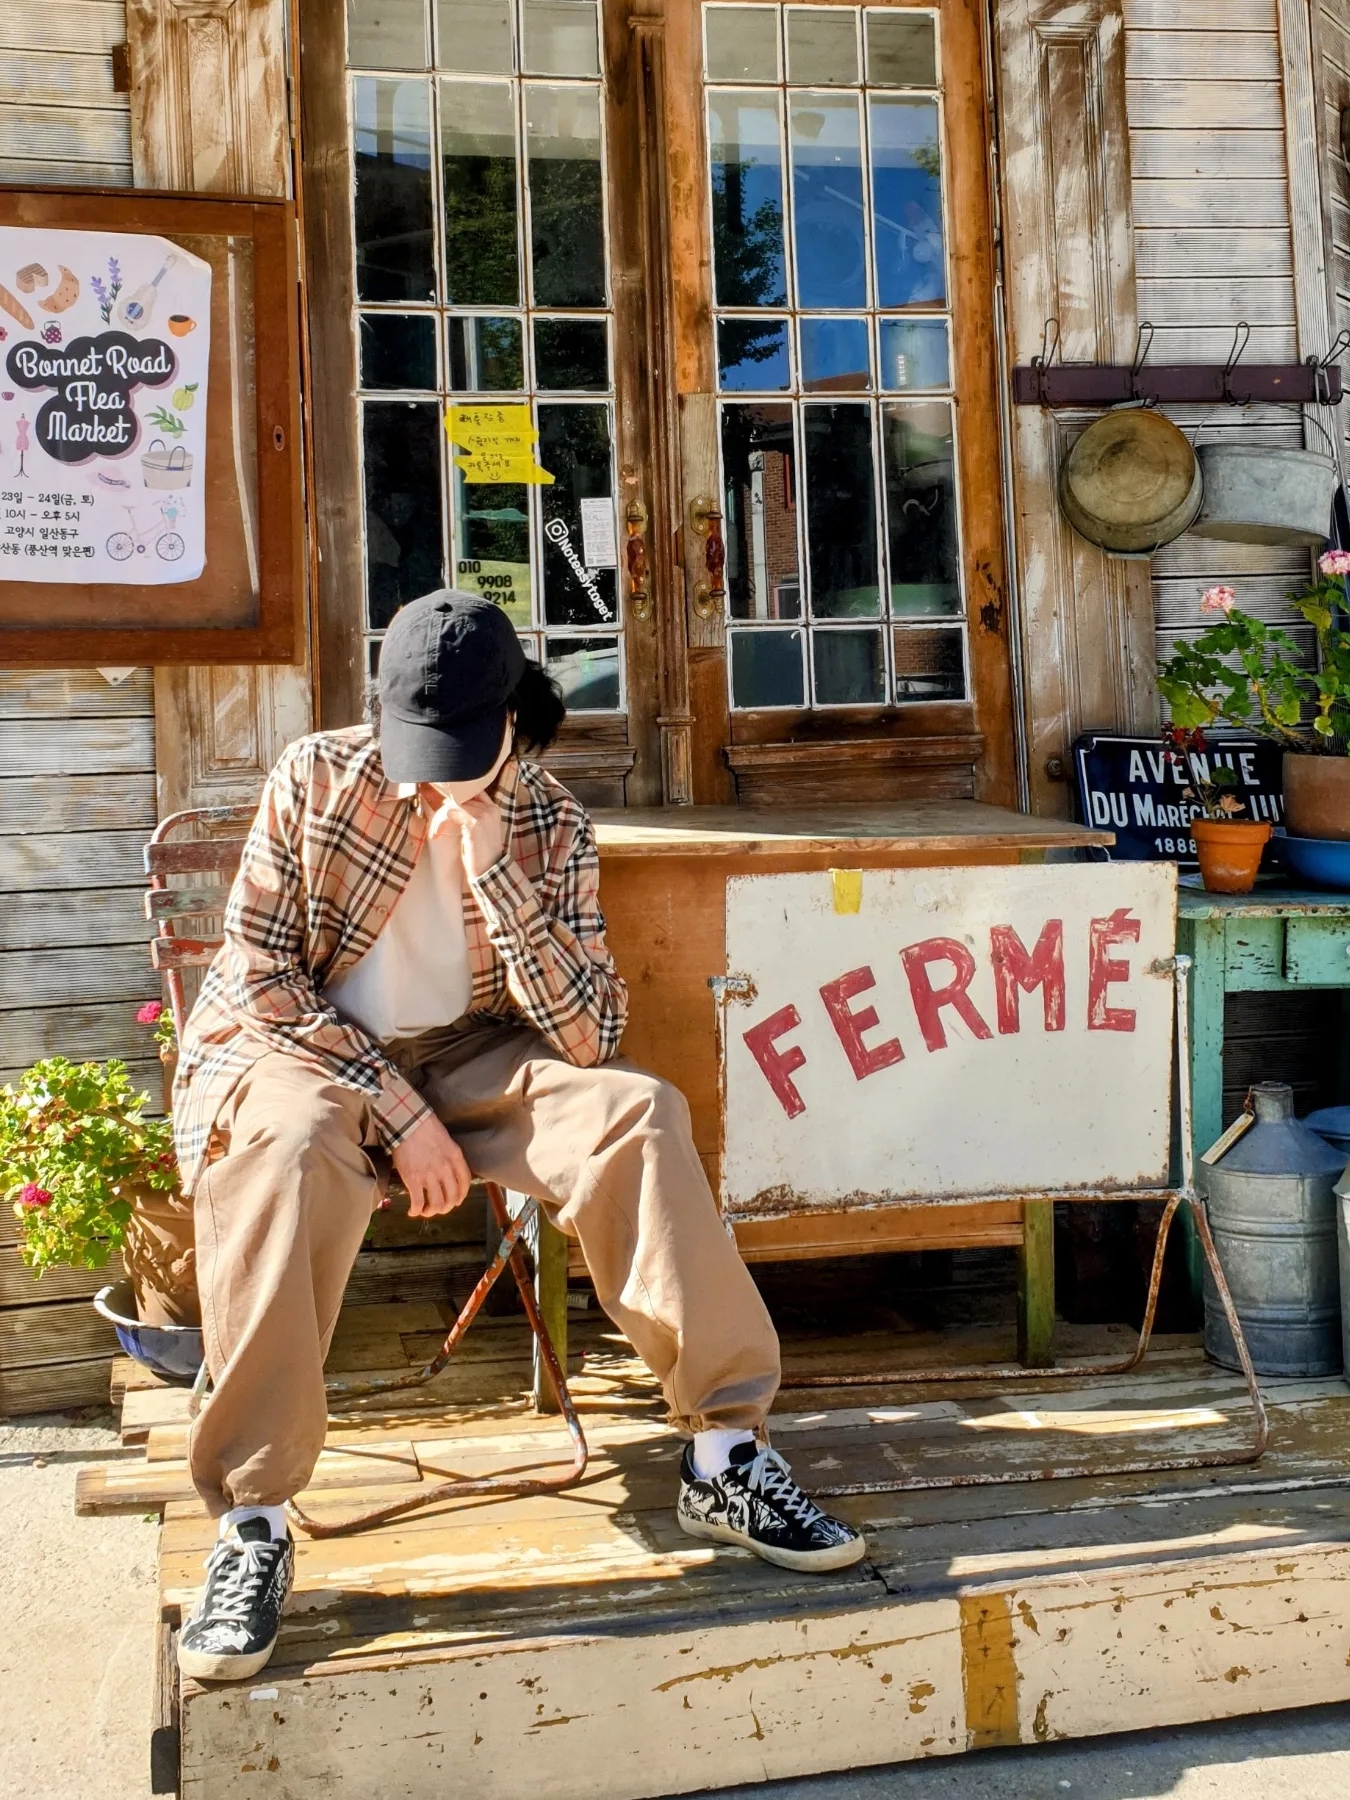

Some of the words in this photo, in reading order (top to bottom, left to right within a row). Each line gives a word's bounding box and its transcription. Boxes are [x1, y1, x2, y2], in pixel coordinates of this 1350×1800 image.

[15, 346, 103, 378] Bonnet
[105, 345, 172, 379] Road
[65, 381, 125, 412] Flea
[46, 411, 131, 444] Market
[1, 492, 23, 504] 23일
[5, 509, 26, 520] 10시
[41, 510, 61, 521] 오후
[64, 511, 80, 522] 5시
[4, 526, 35, 538] 고양시
[39, 527, 79, 540] 일산동구
[0, 542, 21, 555] 산동
[62, 545, 95, 558] 맞은편)
[458, 560, 481, 574] 010
[477, 575, 513, 589] 9908
[558, 538, 613, 621] Noteasytoget
[1091, 791, 1129, 827] DU
[742, 908, 1141, 1120] FERMÉ
